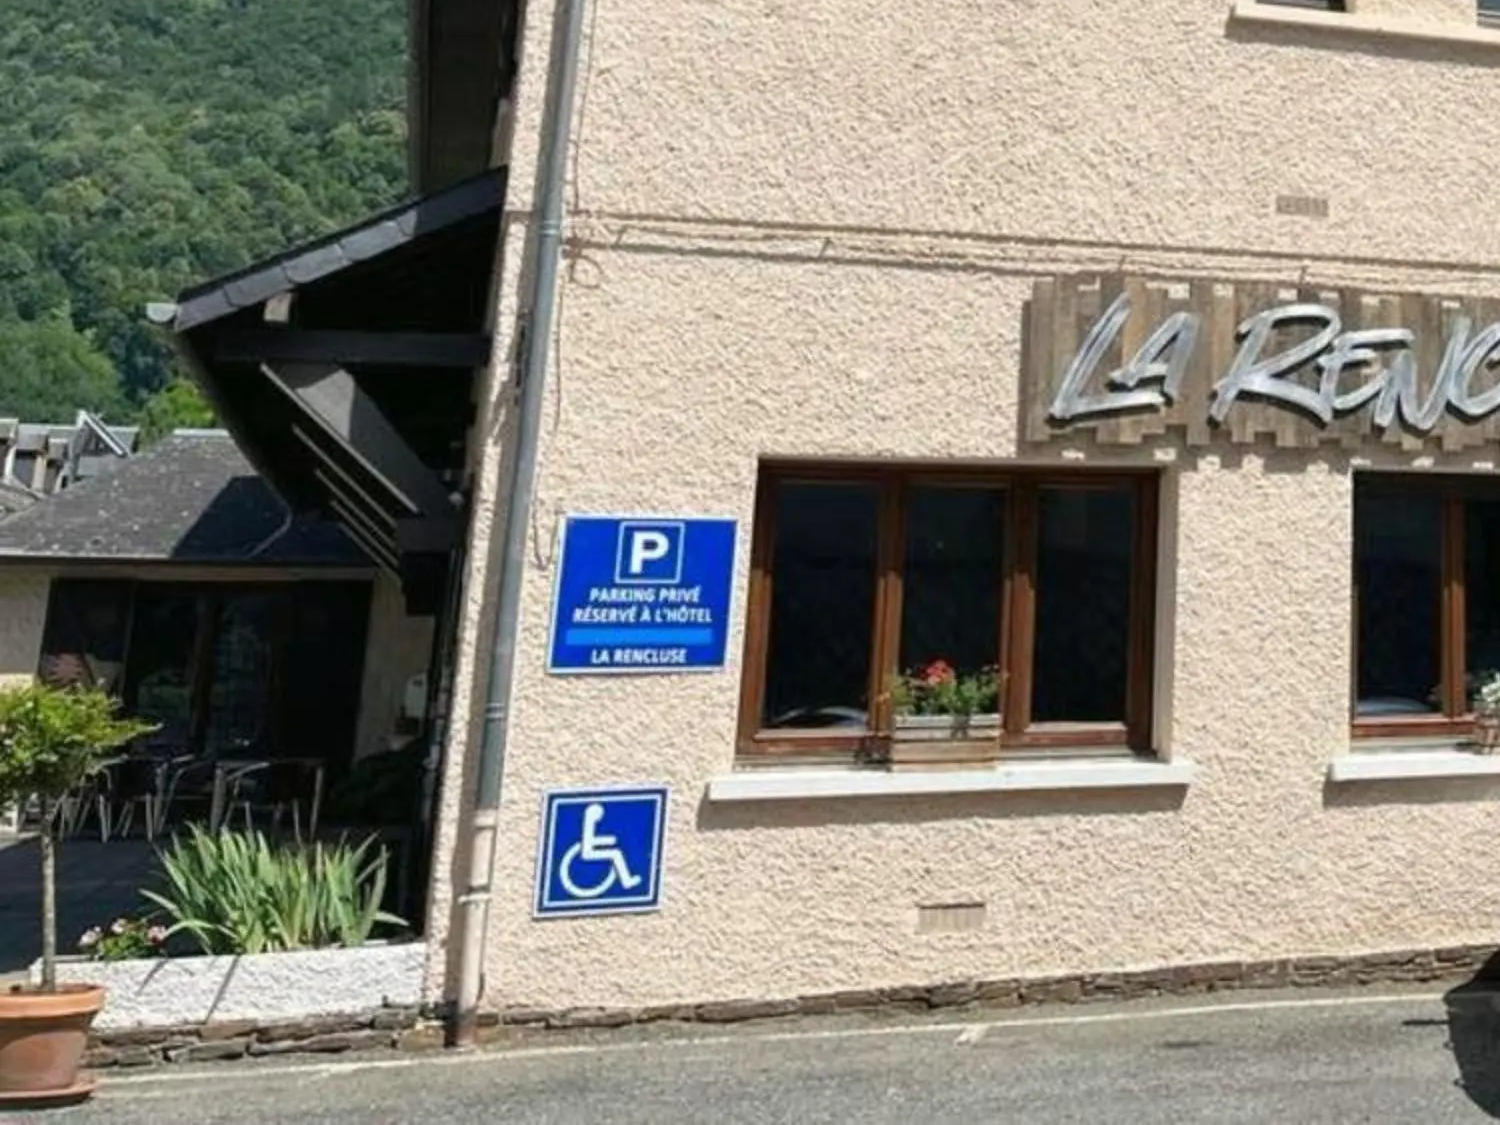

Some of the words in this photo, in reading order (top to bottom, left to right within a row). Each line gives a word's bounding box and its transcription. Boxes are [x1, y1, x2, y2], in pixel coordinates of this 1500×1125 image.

[1049, 291, 1198, 422] LA
[628, 530, 670, 574] P
[588, 587, 655, 602] PARKING
[658, 585, 702, 602] PRIVÉ
[572, 605, 638, 623] RÉSERVÉ
[639, 605, 651, 622] À
[654, 606, 712, 623] L'HÔTEL
[591, 648, 610, 664] LA
[613, 648, 687, 664] RENCLUSE
